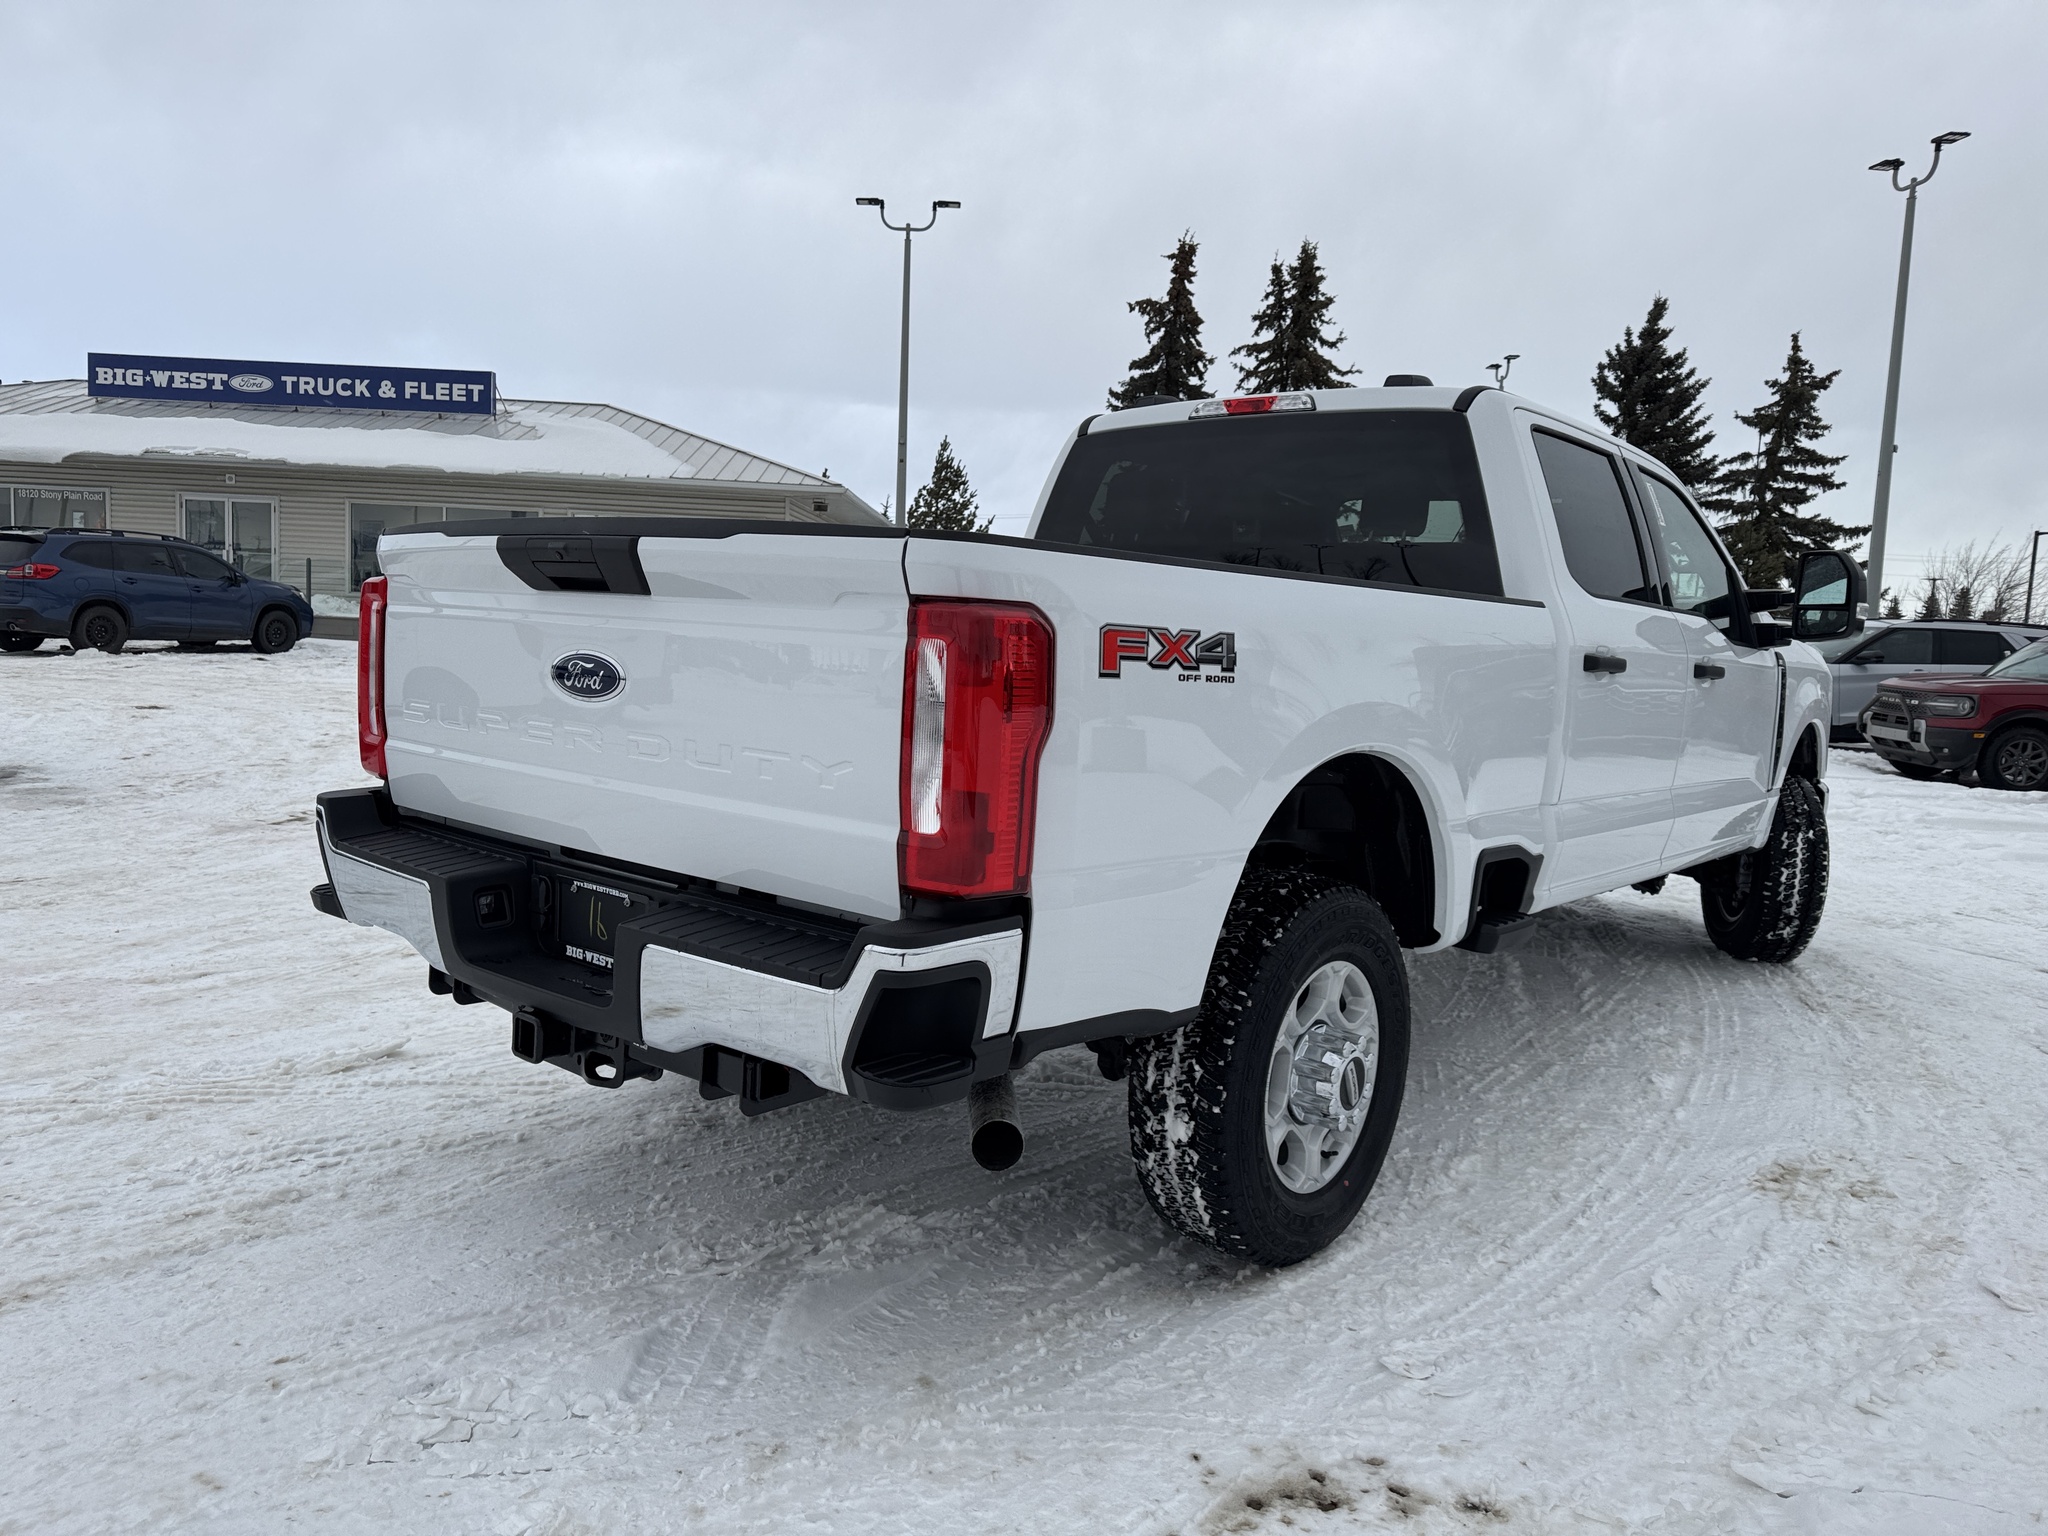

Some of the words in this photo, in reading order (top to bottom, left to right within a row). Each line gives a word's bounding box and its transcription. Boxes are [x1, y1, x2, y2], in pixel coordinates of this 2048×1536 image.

[233, 375, 270, 391] Ford
[280, 375, 373, 398] TRUCK
[378, 379, 397, 399] &
[404, 381, 485, 403] FLEET
[17, 488, 39, 498] 18120
[40, 489, 62, 501] Stony
[63, 490, 82, 500] Plain
[83, 491, 103, 501] Road
[1098, 622, 1237, 679] FX4
[562, 659, 604, 691] Ford
[1178, 673, 1202, 683] OFF
[1205, 674, 1236, 684] ROAD
[403, 699, 603, 753] SUPER
[626, 730, 854, 790] DUTY
